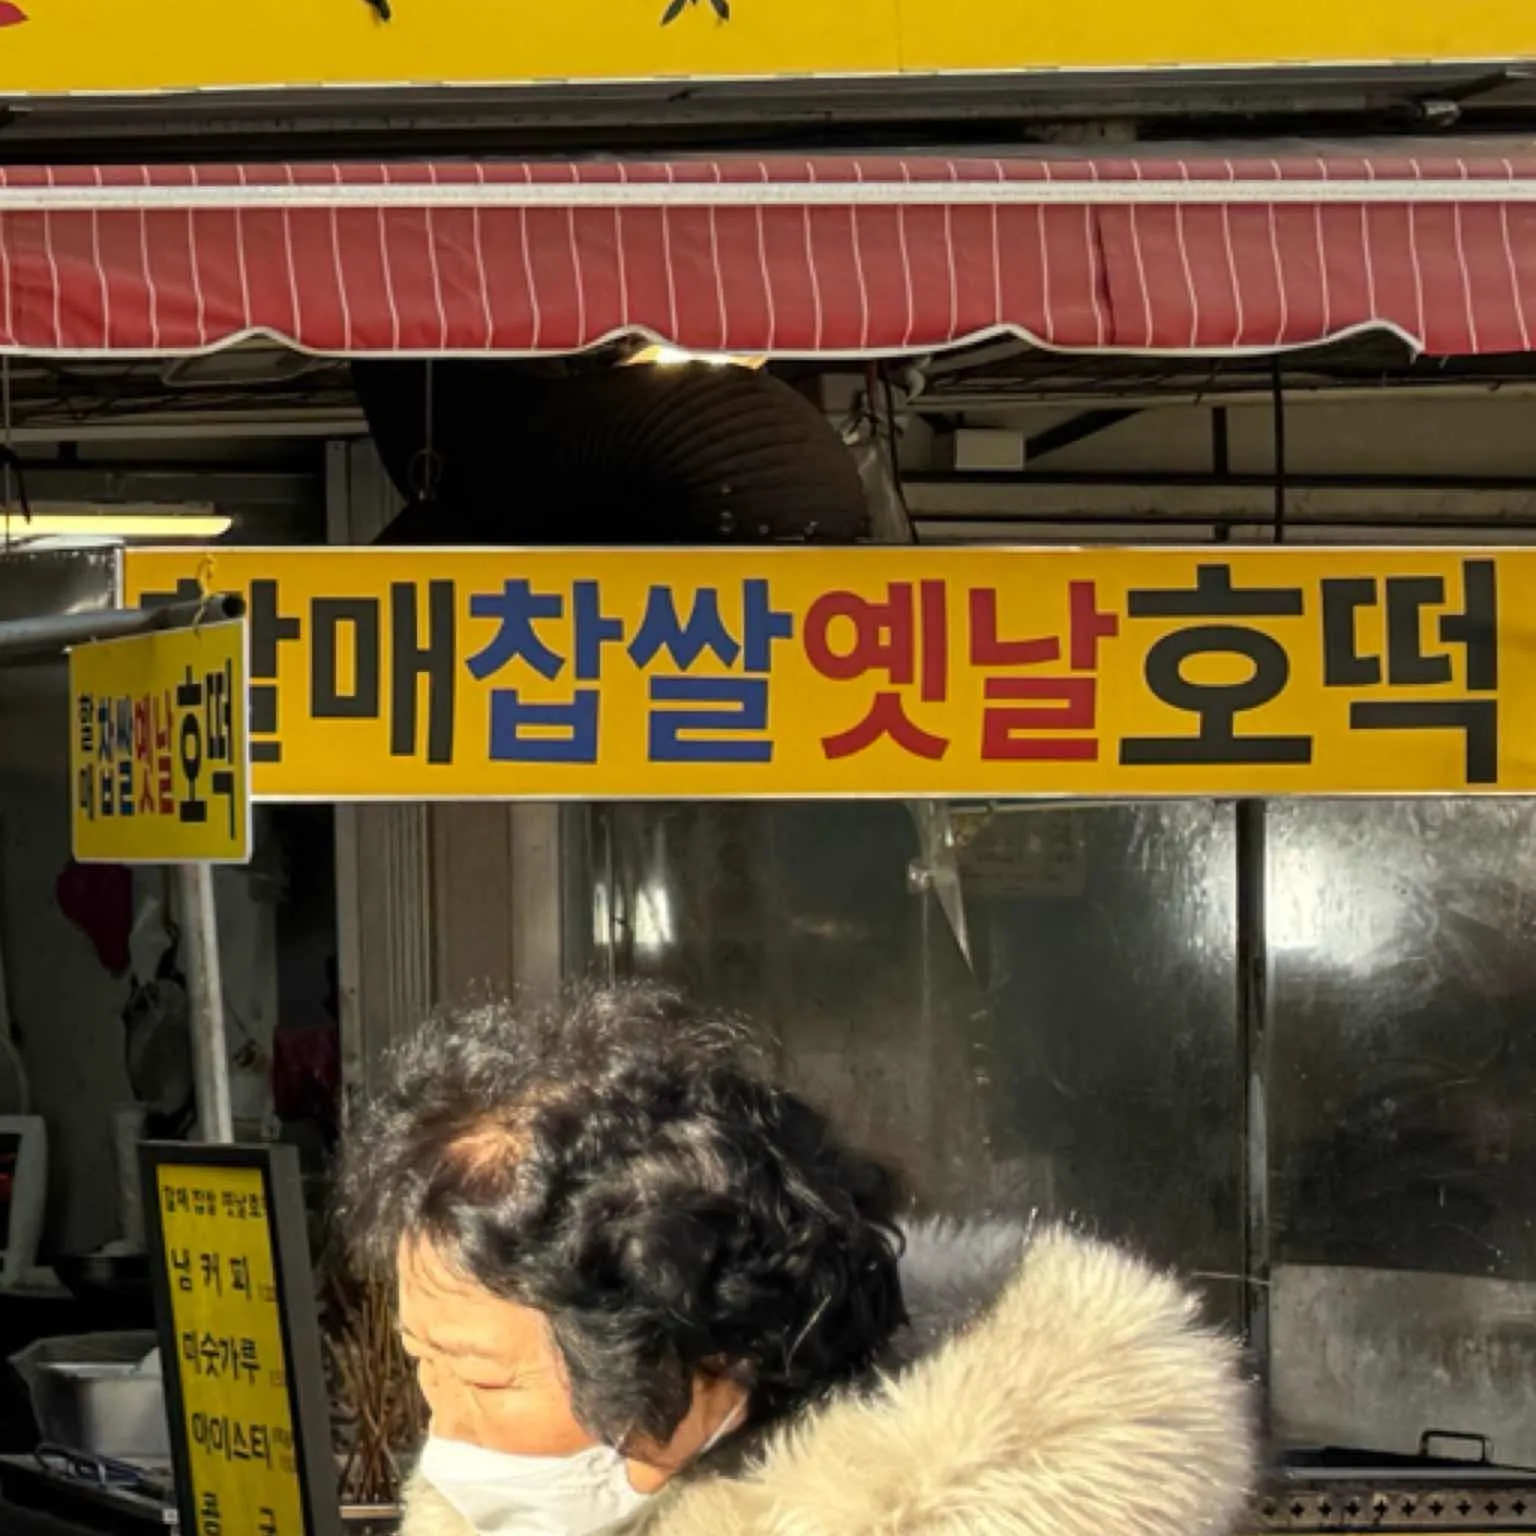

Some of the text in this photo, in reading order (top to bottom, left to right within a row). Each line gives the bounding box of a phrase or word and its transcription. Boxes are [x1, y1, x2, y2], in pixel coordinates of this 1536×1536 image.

[465, 578, 793, 766] 찹쌀
[801, 579, 1119, 761] 옛날
[1119, 560, 1499, 785] 호떡
